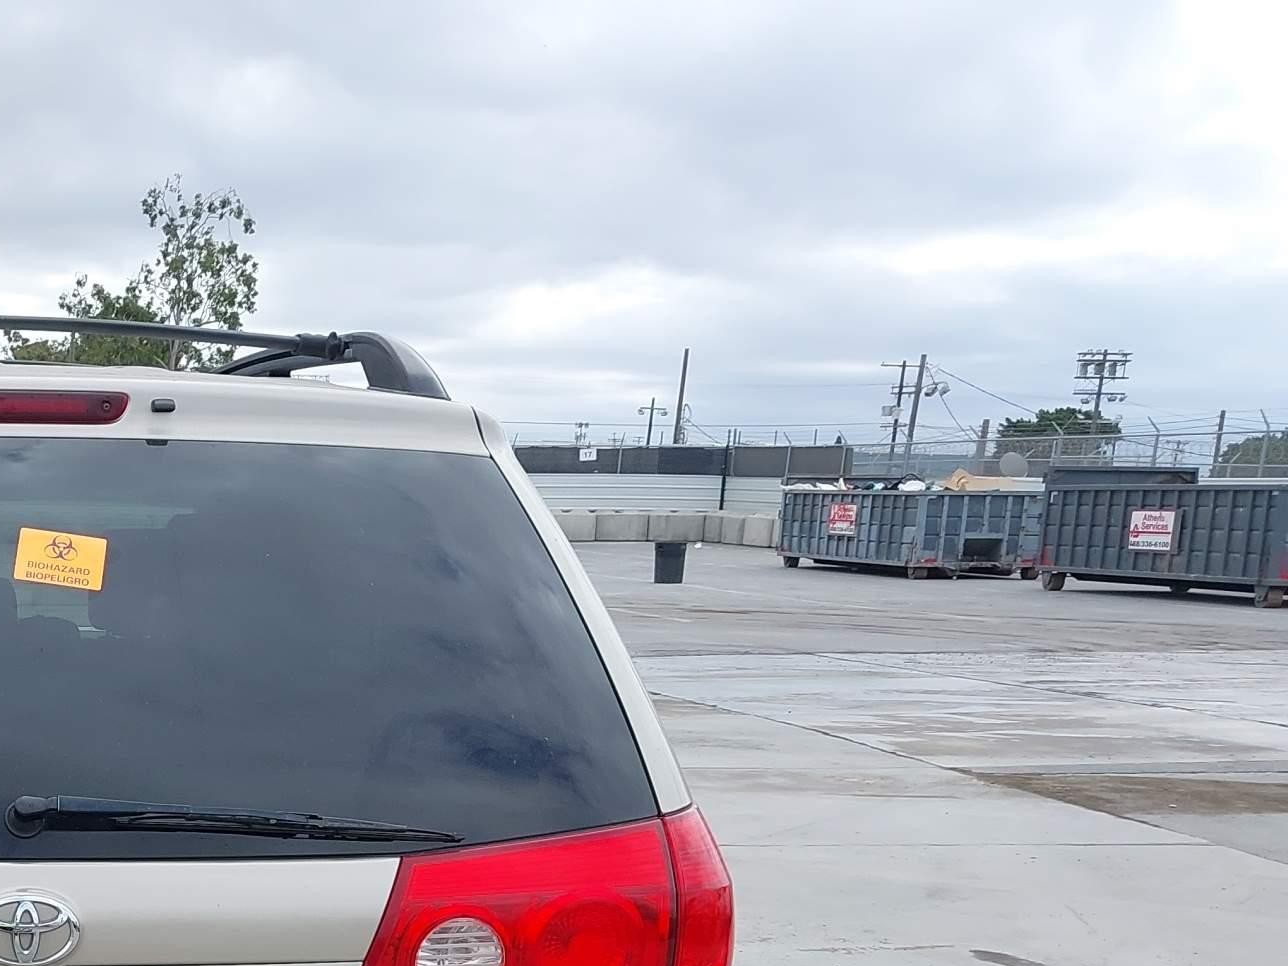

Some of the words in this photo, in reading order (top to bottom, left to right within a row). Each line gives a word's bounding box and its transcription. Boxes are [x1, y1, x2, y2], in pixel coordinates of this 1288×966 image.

[1141, 522, 1168, 530] Services
[27, 560, 90, 576] BIOHAZARD
[25, 570, 89, 586] BIOPELIGRO
